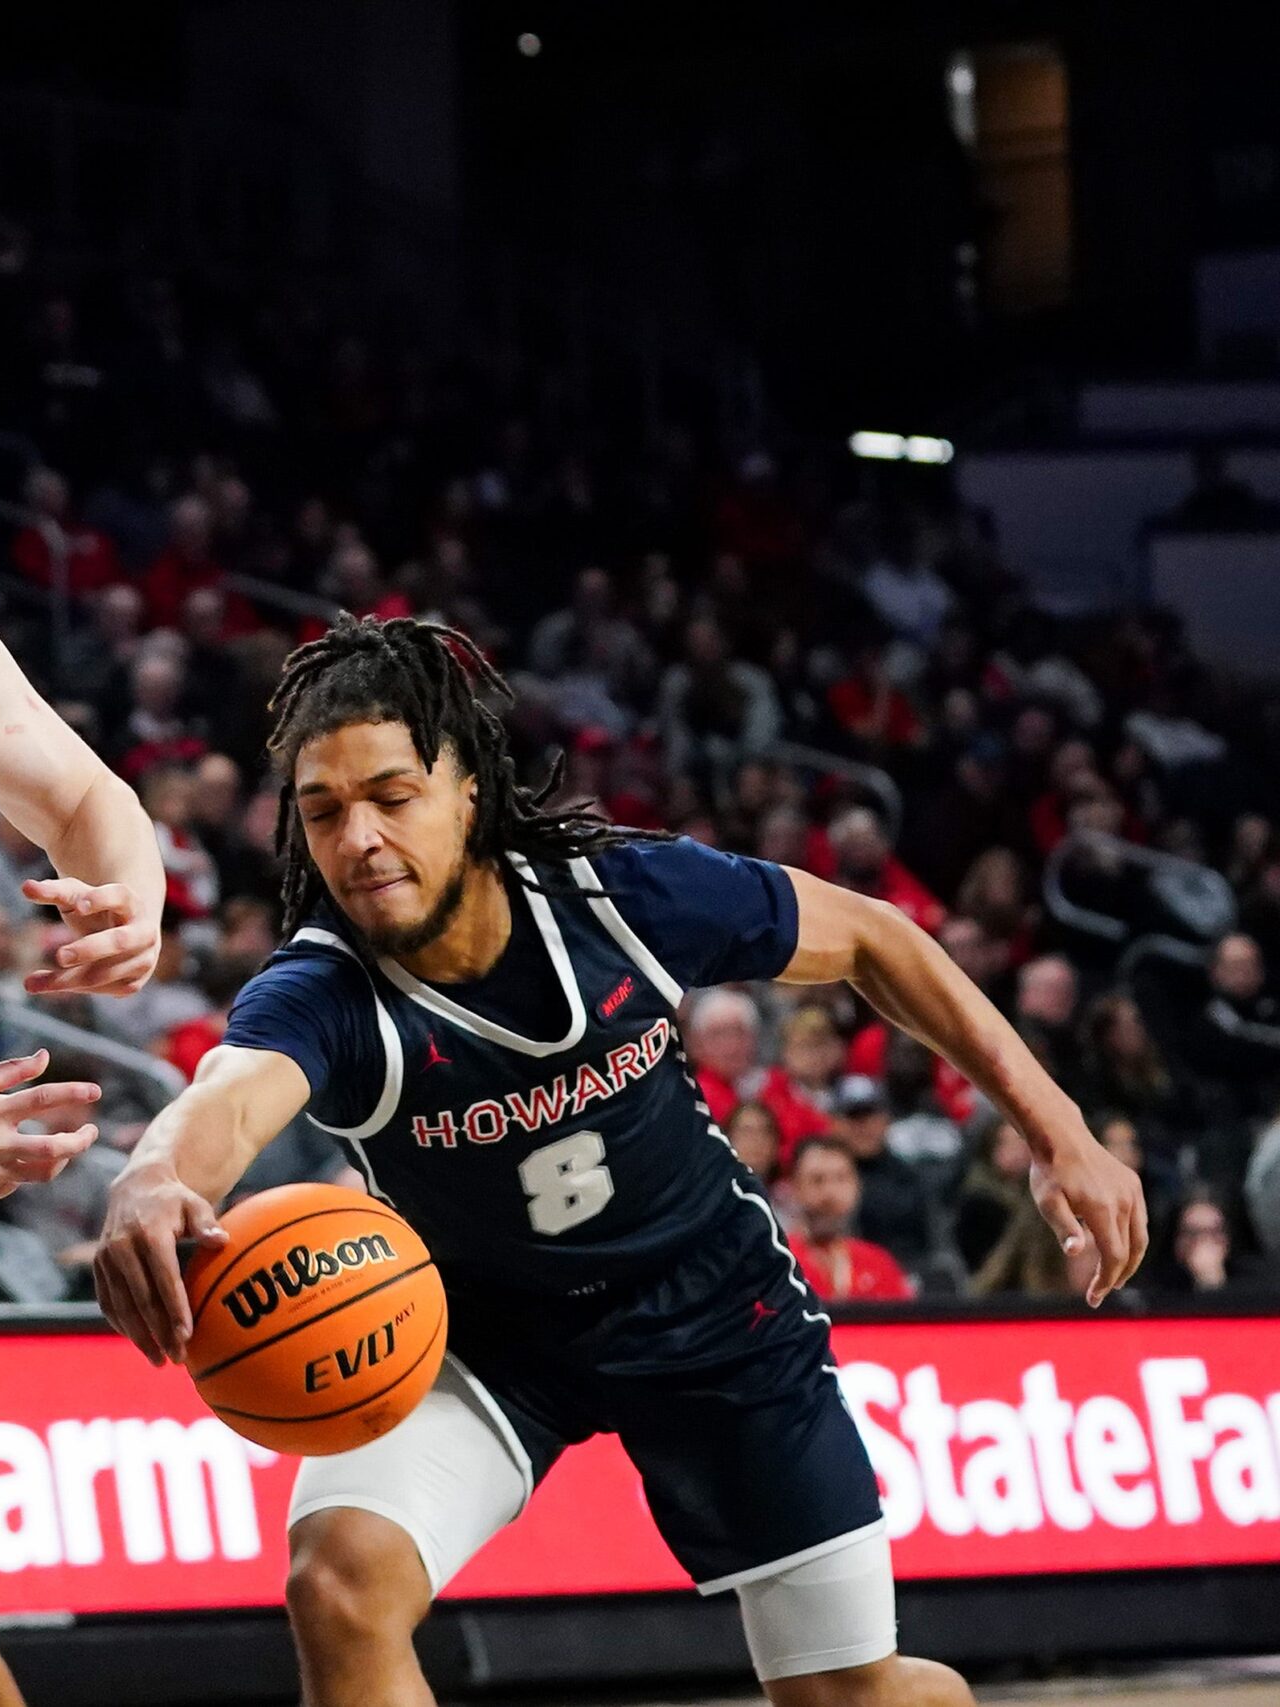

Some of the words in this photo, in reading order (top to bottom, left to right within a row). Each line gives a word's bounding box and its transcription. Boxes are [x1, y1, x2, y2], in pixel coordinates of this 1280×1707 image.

[411, 1017, 670, 1149] HOWARD
[517, 1130, 615, 1236] 8
[221, 1232, 397, 1329] Wilson
